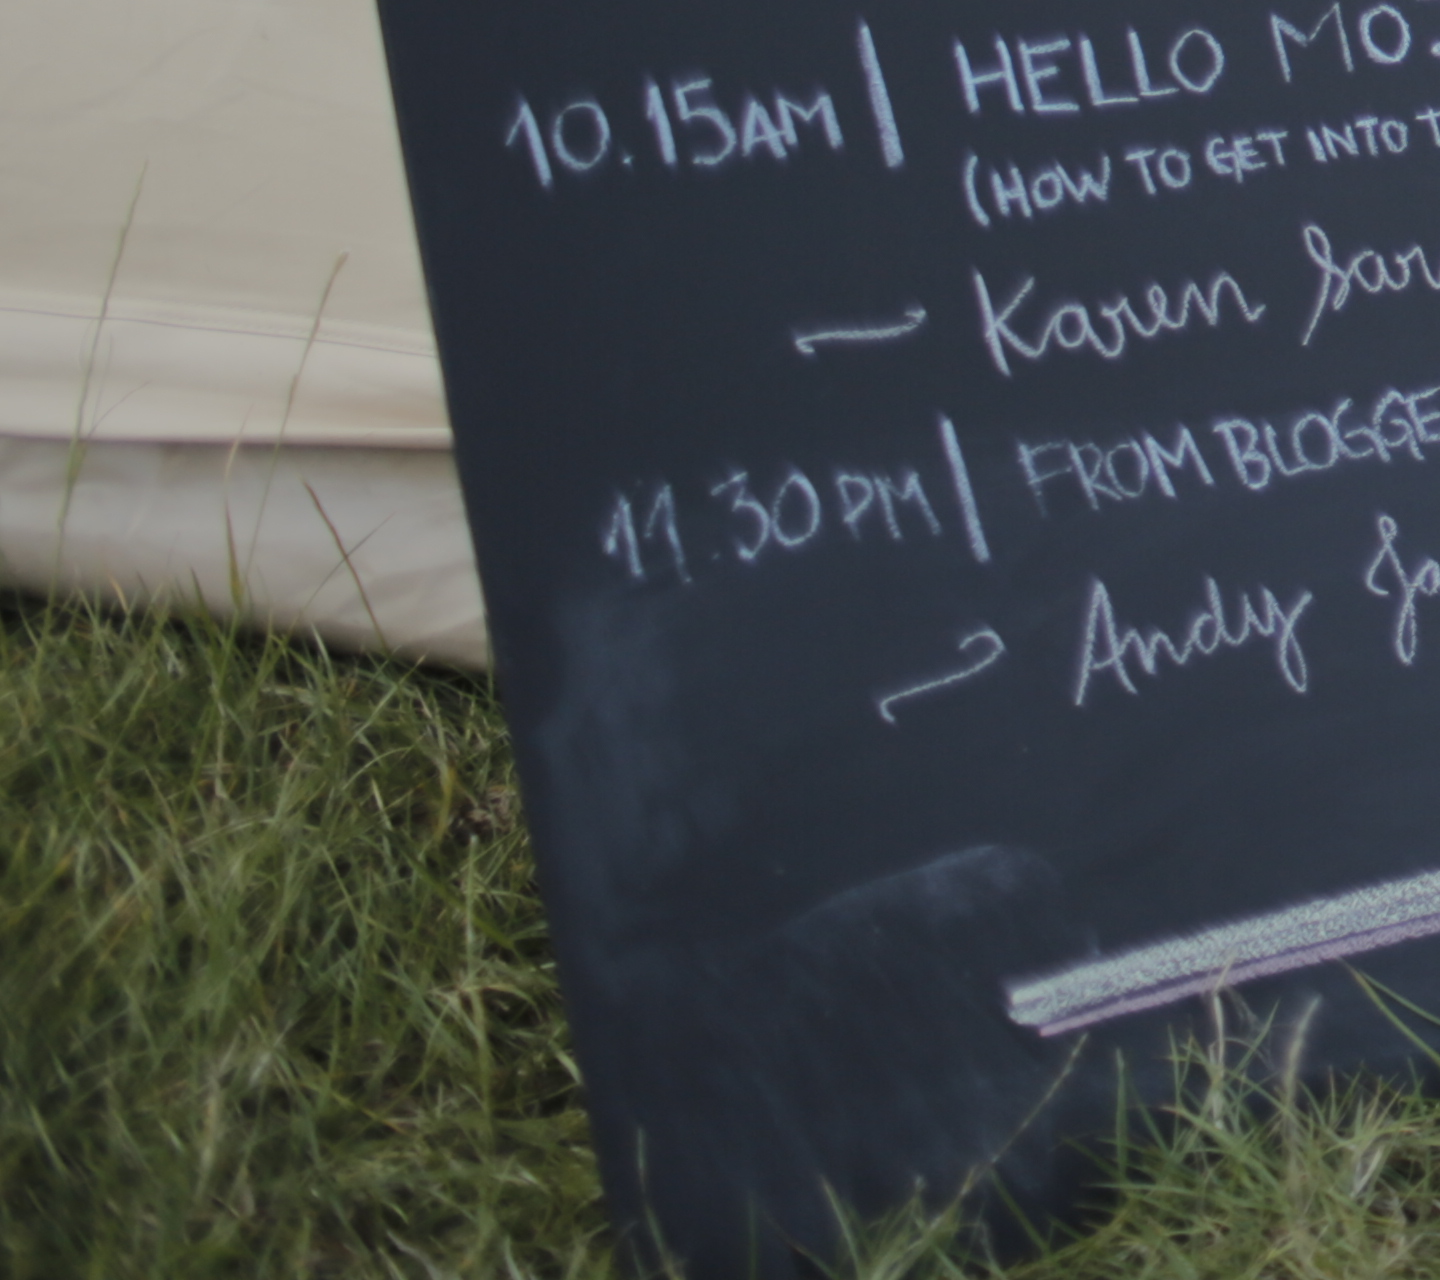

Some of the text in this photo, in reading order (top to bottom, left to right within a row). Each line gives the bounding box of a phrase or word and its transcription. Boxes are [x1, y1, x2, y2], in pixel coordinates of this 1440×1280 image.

[955, 28, 1225, 113] HELLO
[963, 154, 1110, 227] (HOW
[1125, 149, 1191, 195] TO
[1206, 130, 1289, 182] GET
[1308, 115, 1409, 163] INTO
[975, 270, 1266, 376] Karen
[1017, 424, 1215, 520] FROM
[1076, 576, 1312, 706] Andy
